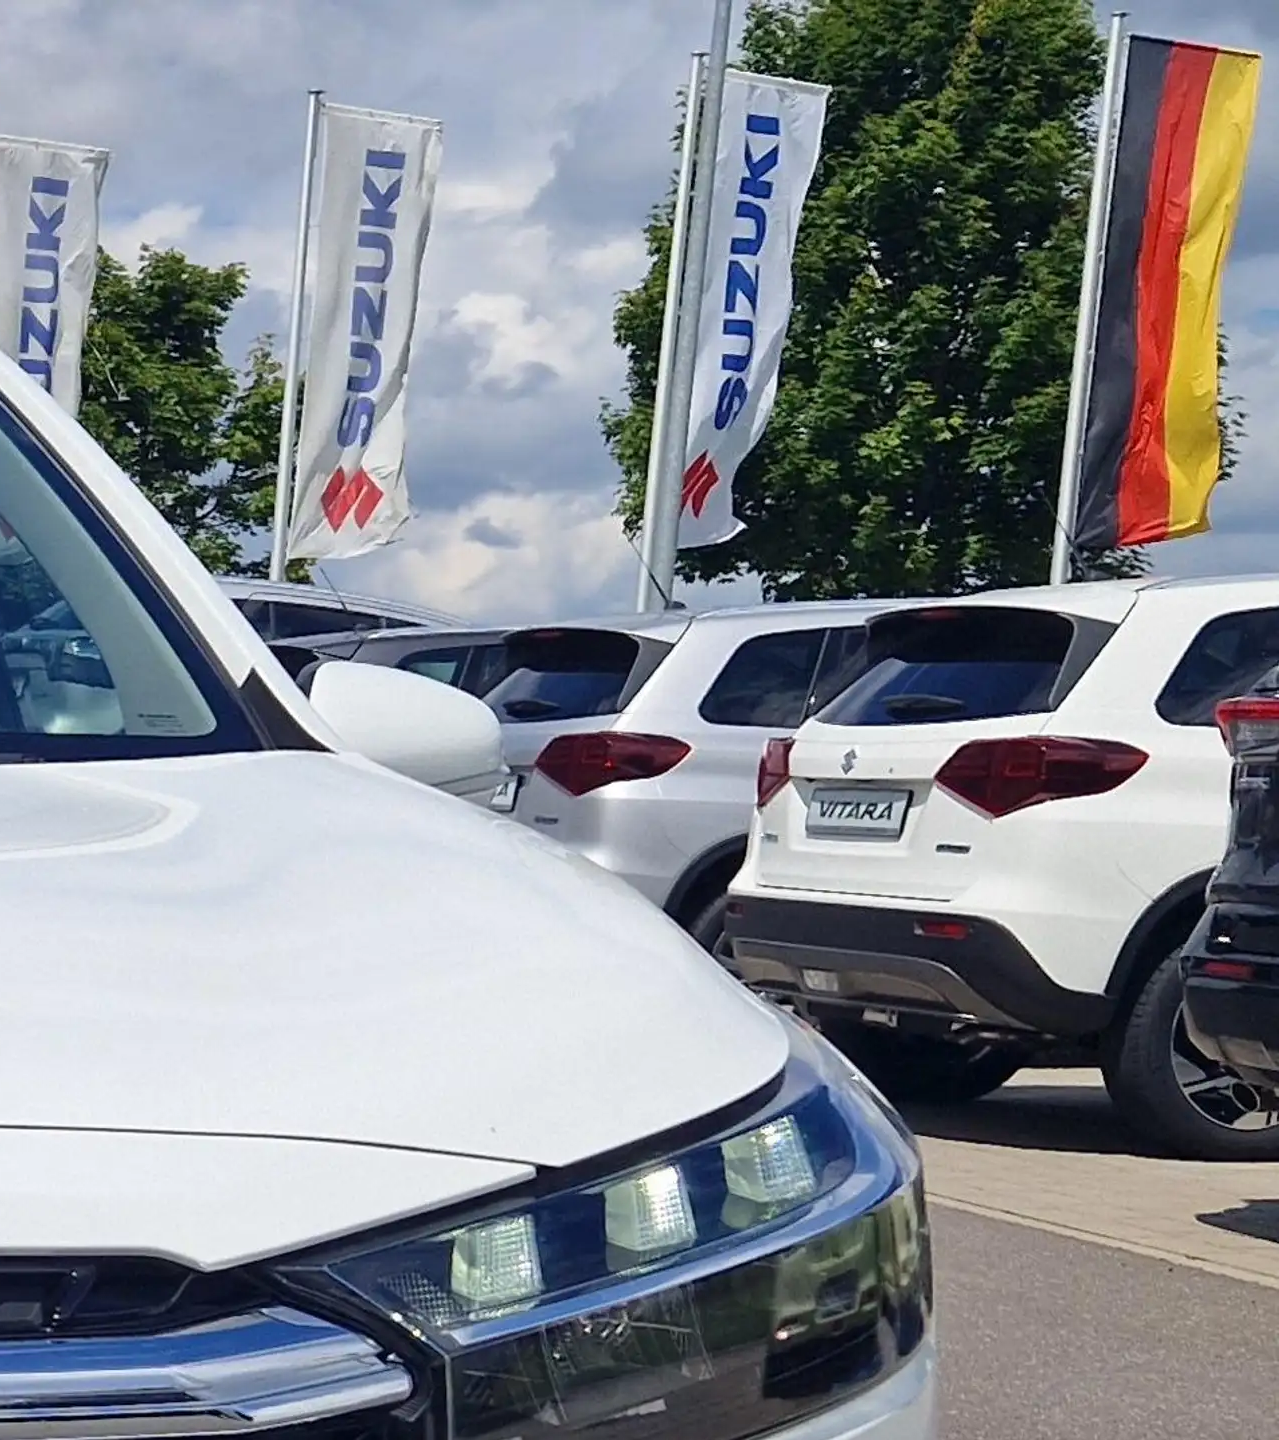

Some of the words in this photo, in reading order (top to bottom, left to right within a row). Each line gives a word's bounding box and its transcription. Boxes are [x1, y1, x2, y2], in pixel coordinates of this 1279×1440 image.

[337, 148, 406, 448] SUZUKI
[714, 113, 781, 431] SUZUKI
[818, 801, 892, 820] VITARA
